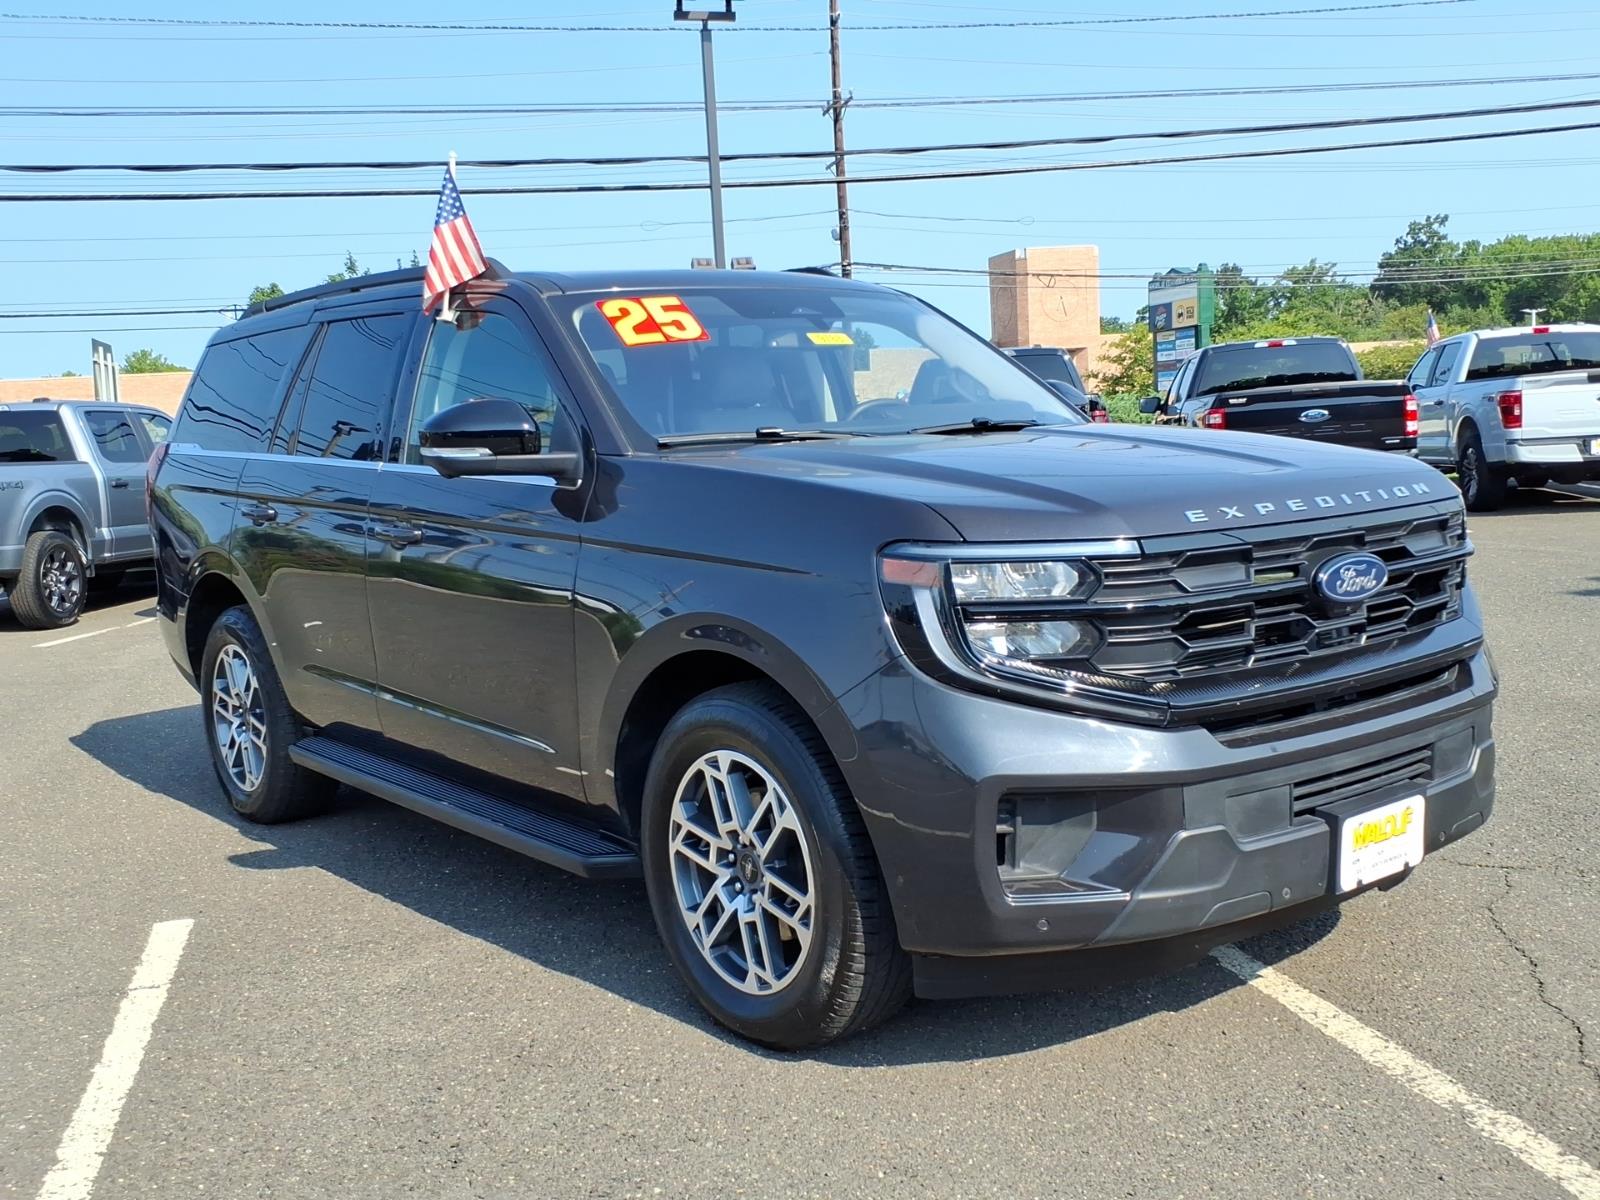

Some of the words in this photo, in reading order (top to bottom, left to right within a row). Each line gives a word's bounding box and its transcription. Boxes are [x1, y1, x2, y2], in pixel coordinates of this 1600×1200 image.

[601, 296, 703, 346] 25
[1184, 482, 1431, 523] EXPEDITION
[1336, 563, 1378, 593] Ford
